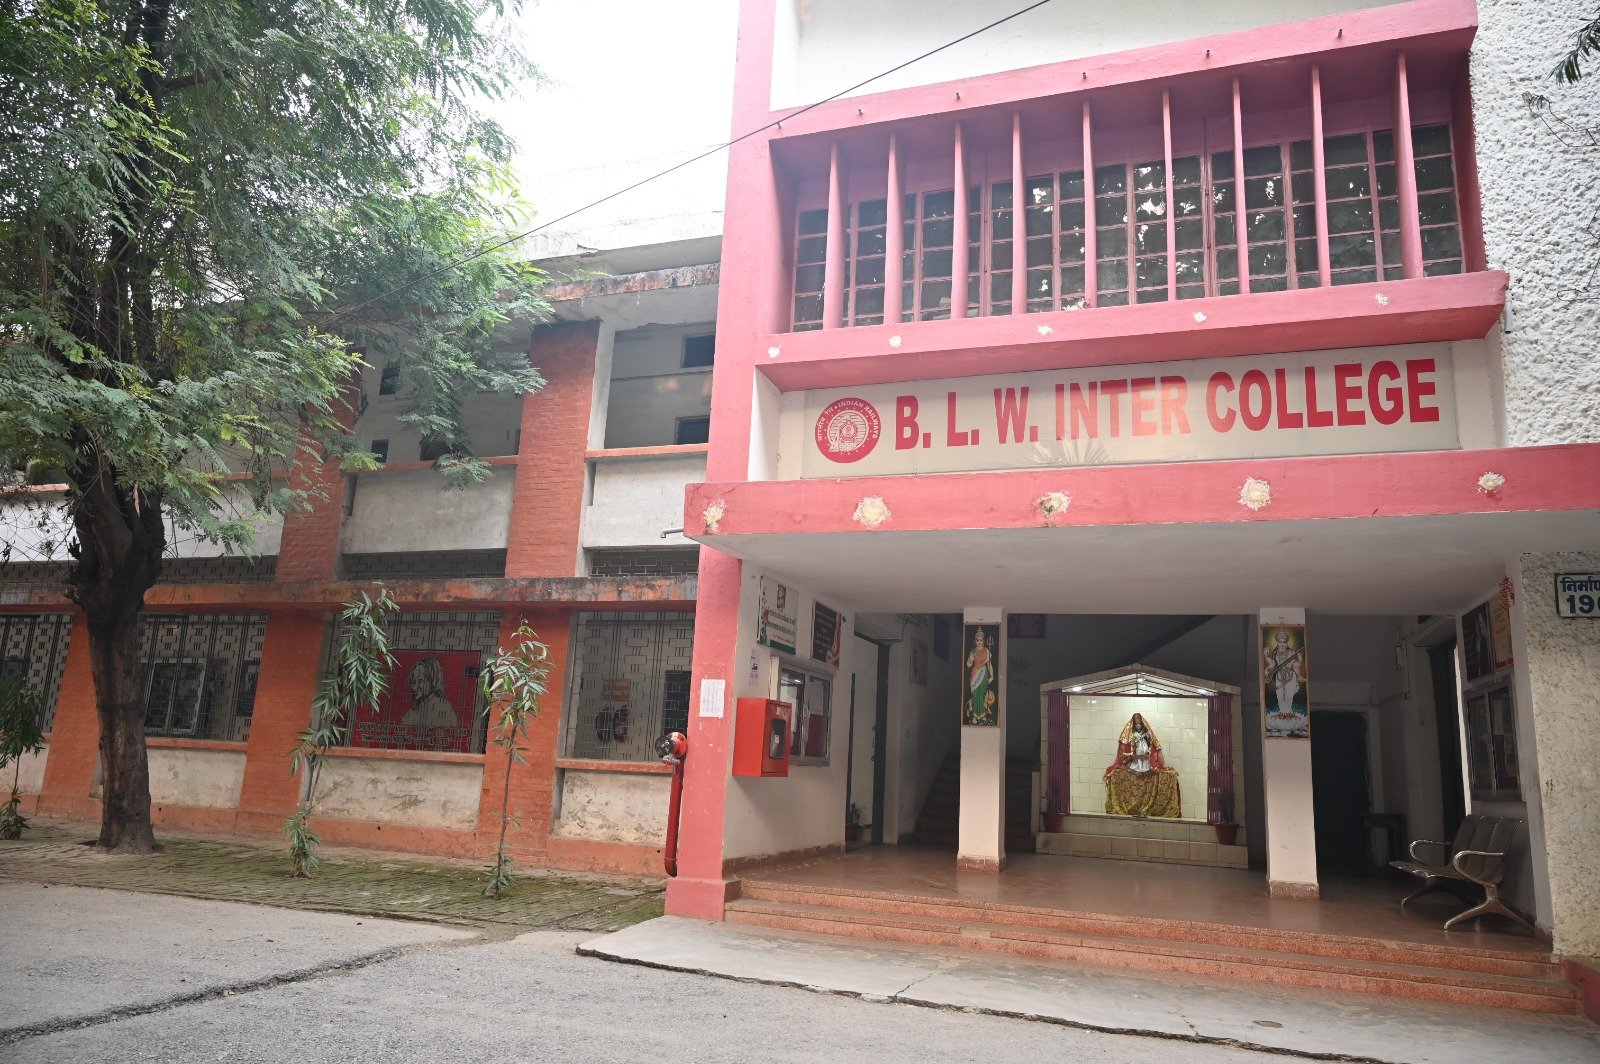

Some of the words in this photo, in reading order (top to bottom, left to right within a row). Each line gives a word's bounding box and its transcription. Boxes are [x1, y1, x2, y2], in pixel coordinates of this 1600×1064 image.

[838, 400, 864, 408] INDIAN
[864, 405, 879, 439] RAILWAYS
[895, 395, 931, 450] B.
[947, 392, 980, 447] L.
[993, 386, 1039, 445] W.
[1055, 375, 1192, 441] INTER
[1206, 358, 1440, 434] COLLEGE
[1567, 594, 1600, 614] 19
